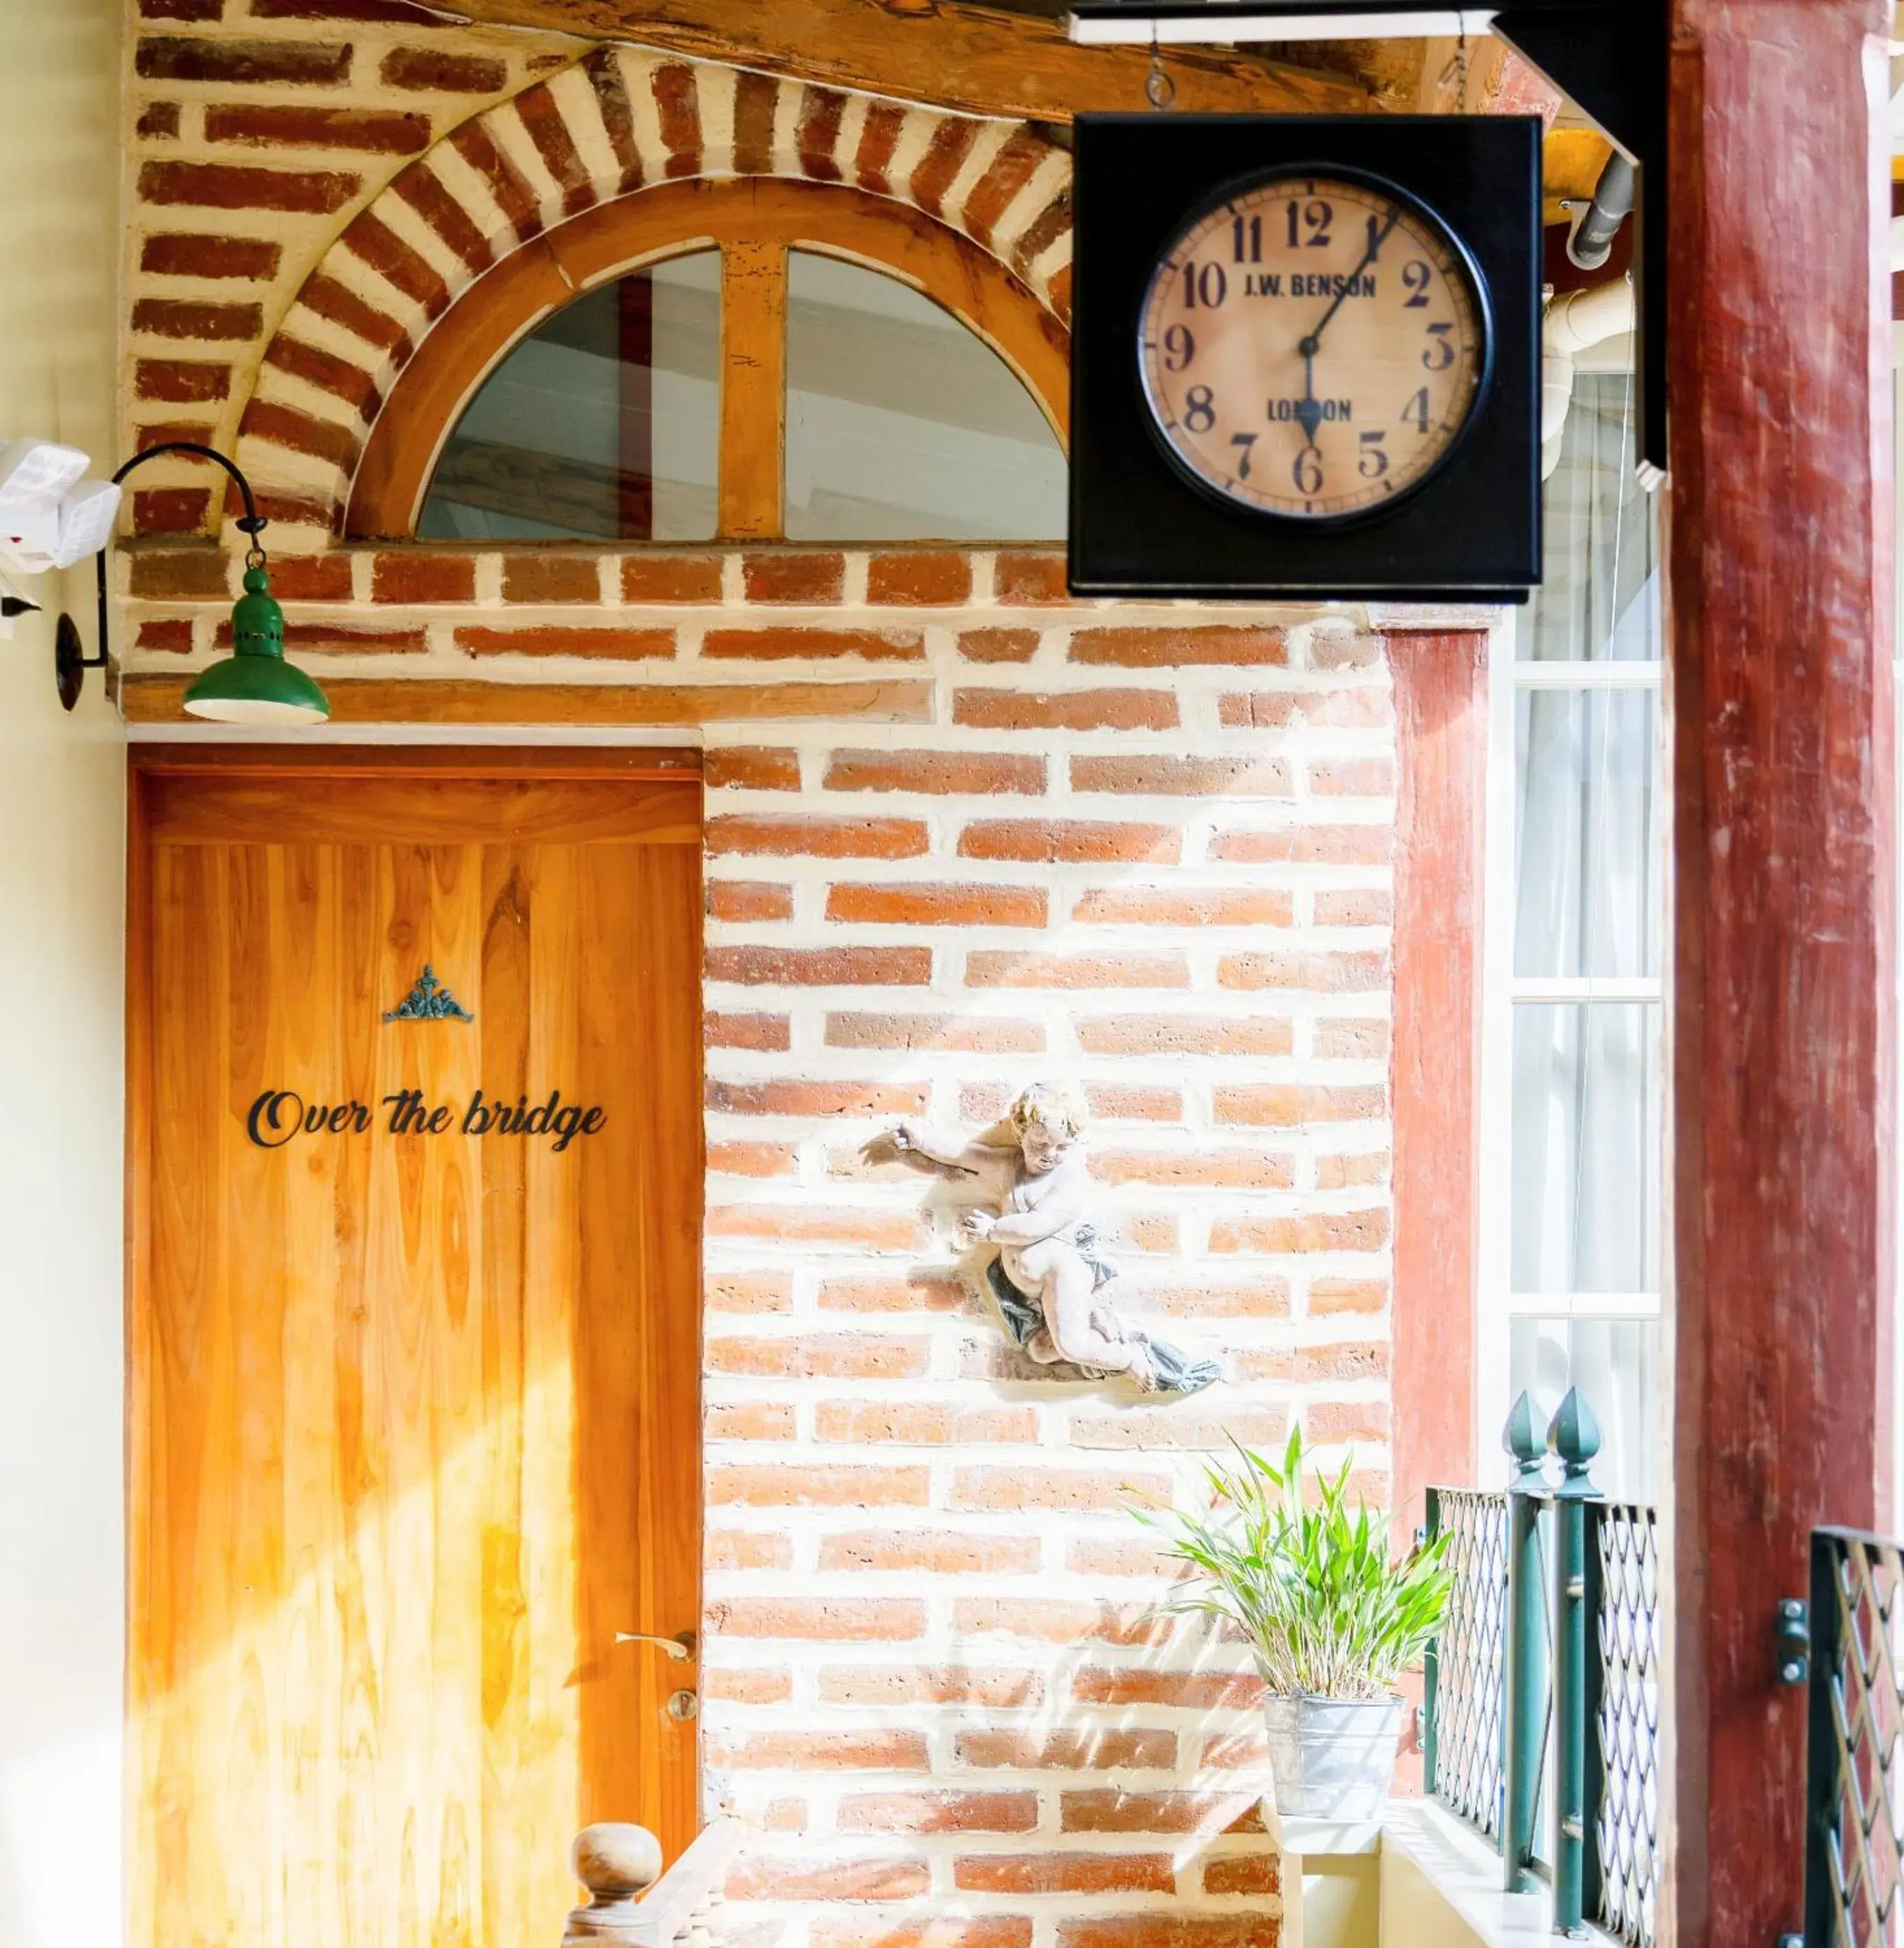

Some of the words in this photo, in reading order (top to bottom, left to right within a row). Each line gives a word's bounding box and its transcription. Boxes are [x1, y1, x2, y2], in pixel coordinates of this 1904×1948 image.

[1233, 215, 1262, 263] 11
[1287, 201, 1333, 248] 12
[1365, 215, 1379, 263] 1
[1182, 261, 1227, 309] 10
[1244, 274, 1284, 297] J.W.
[1291, 274, 1376, 298] BENSON
[1402, 260, 1432, 307] 2
[1164, 324, 1195, 372] 9
[1421, 322, 1455, 371] 3
[1184, 385, 1216, 433] 8
[1266, 398, 1351, 422] LONON
[1400, 385, 1434, 434] 4
[1230, 433, 1259, 480] 7
[1293, 446, 1323, 495] 6
[1358, 430, 1389, 477] 5
[247, 1089, 372, 1147] Over
[382, 1089, 453, 1135] the
[462, 1089, 607, 1151] bridge
